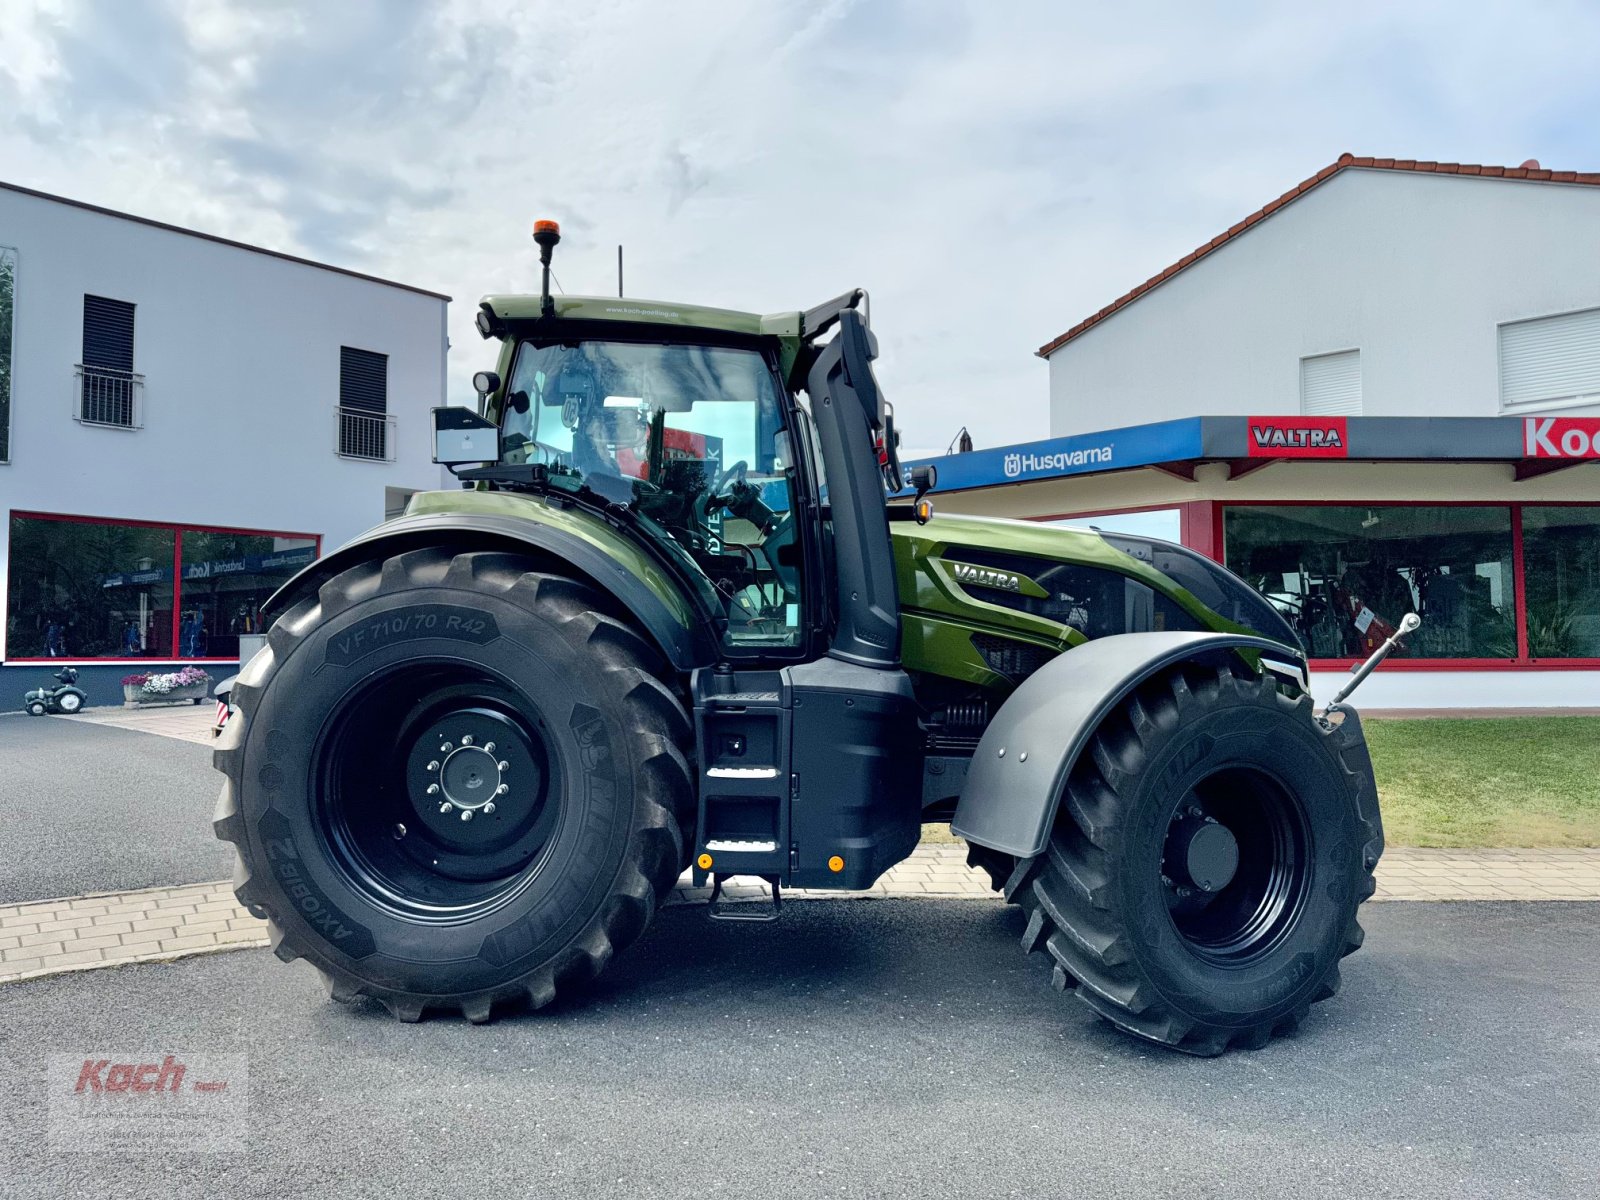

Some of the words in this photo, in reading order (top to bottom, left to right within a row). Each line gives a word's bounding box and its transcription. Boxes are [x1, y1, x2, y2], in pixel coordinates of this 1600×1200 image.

[1251, 426, 1342, 447] VALTRA
[1022, 446, 1112, 473] Husqvarna
[953, 564, 1020, 591] VALTRA
[338, 630, 365, 654] VF
[446, 615, 485, 634] R42
[280, 863, 354, 939] AXIOBIB
